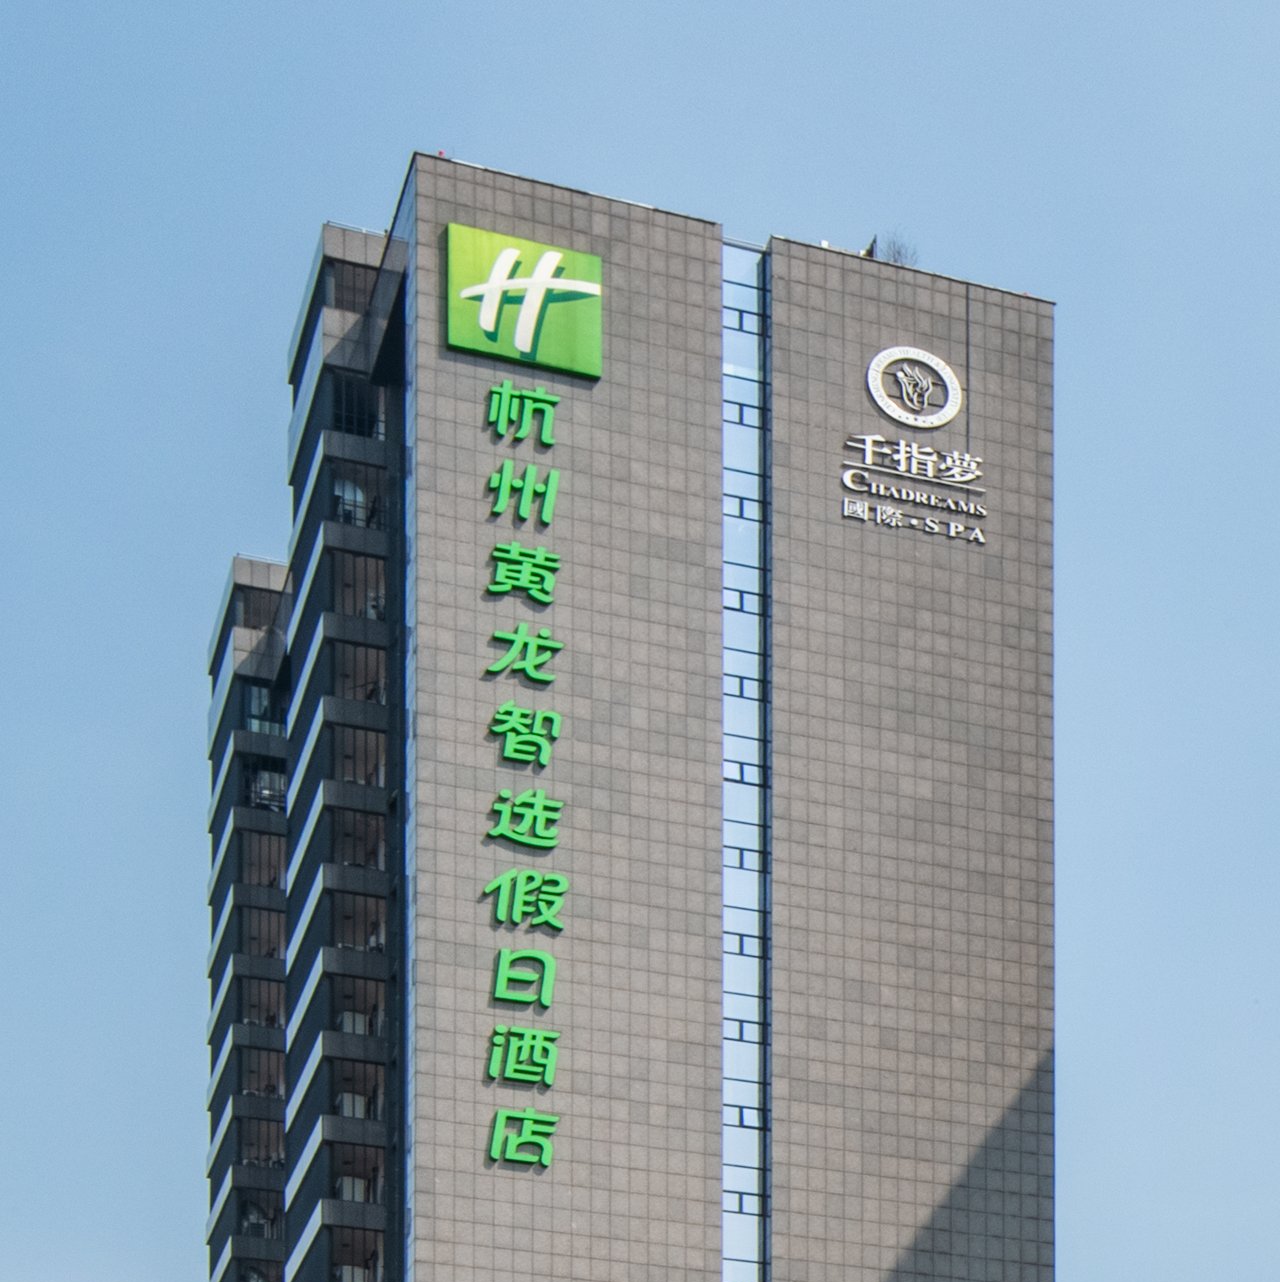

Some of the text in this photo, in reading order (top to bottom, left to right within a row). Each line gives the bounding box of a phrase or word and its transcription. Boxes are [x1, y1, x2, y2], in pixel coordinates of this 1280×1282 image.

[484, 378, 570, 1168] 杭州黄龙智选假日酒店
